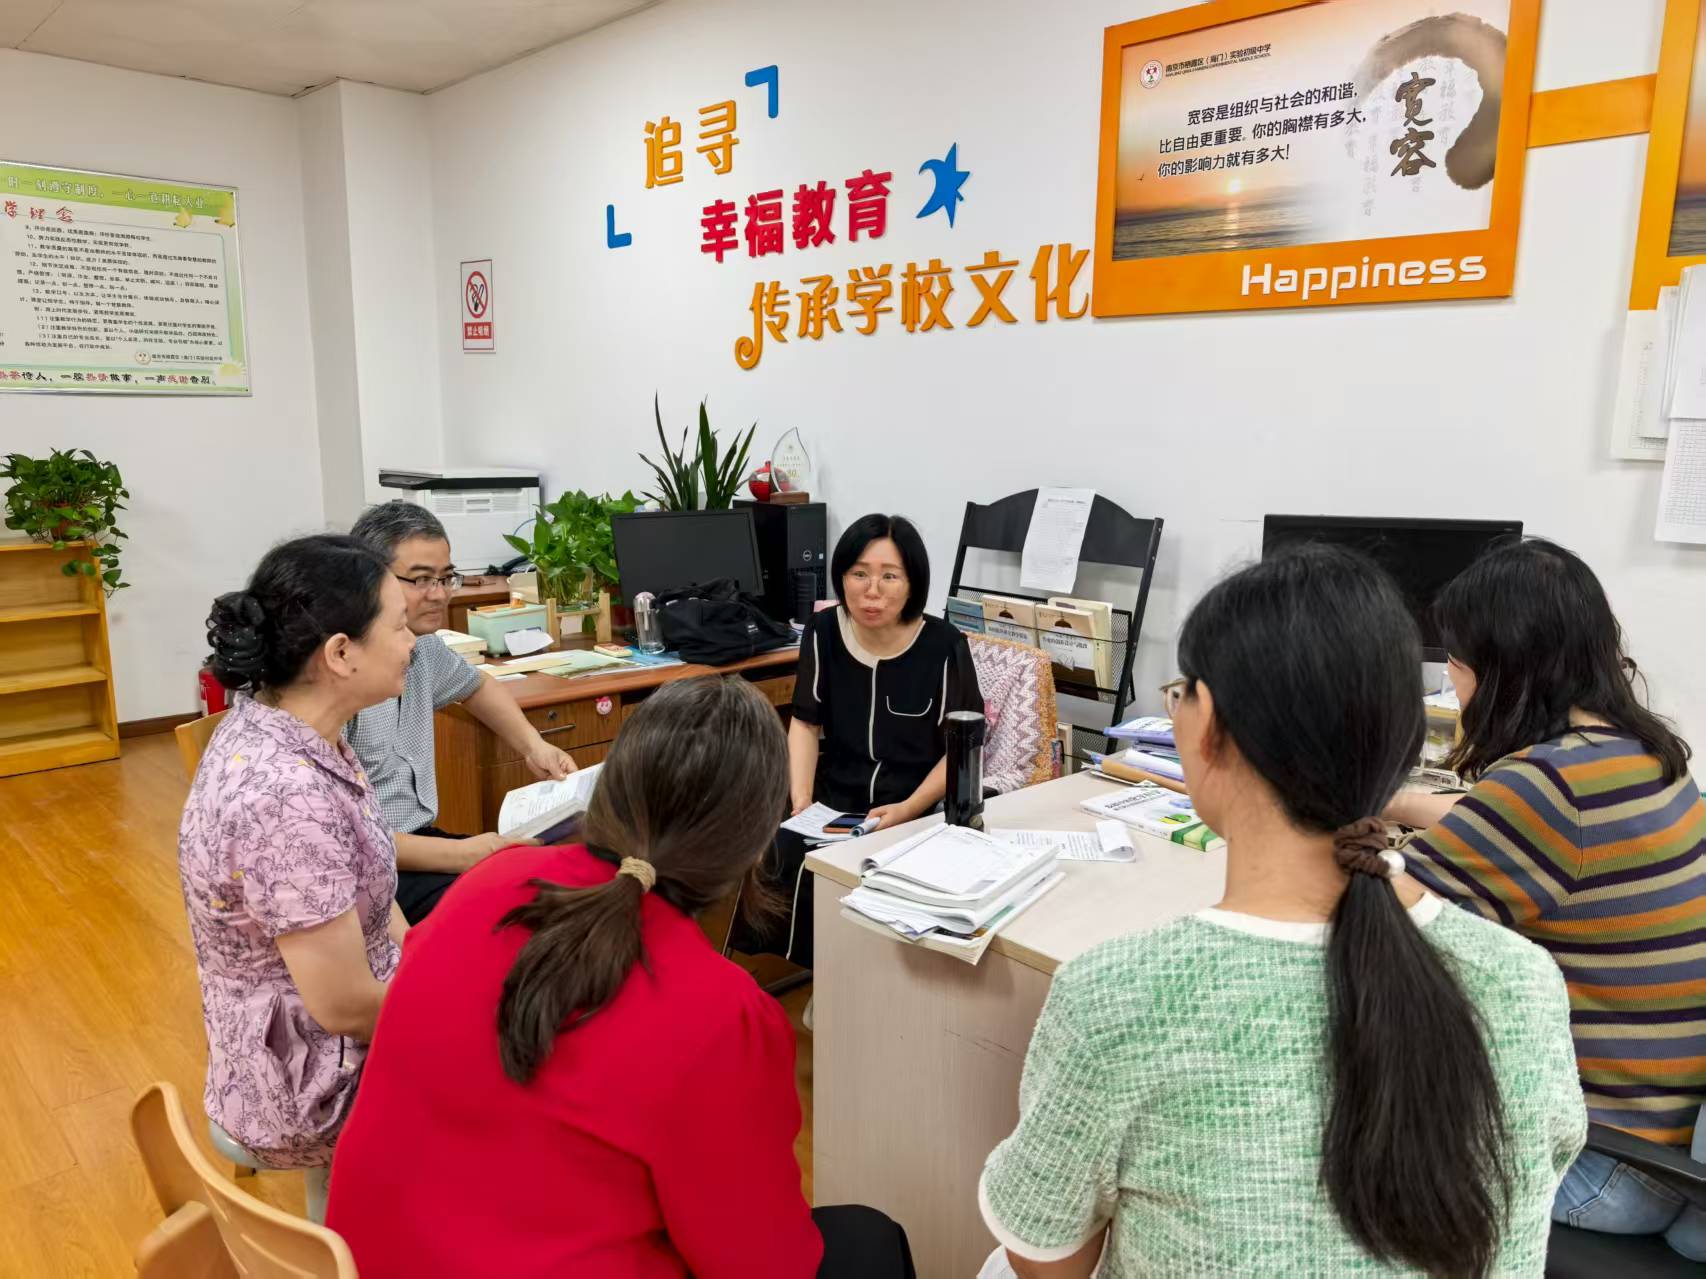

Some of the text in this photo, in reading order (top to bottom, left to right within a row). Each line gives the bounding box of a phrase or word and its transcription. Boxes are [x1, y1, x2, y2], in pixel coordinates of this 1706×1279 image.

[643, 98, 741, 190] 追寻
[1187, 81, 1358, 126] 宽容是组织与社会的和谐，
[1389, 71, 1437, 177] 宽容
[1158, 143, 1291, 178] 你的影响力就有多大！
[699, 168, 894, 264] 幸福教育
[734, 241, 1091, 370] 传承学校文化
[1240, 254, 1488, 300] Happiness
